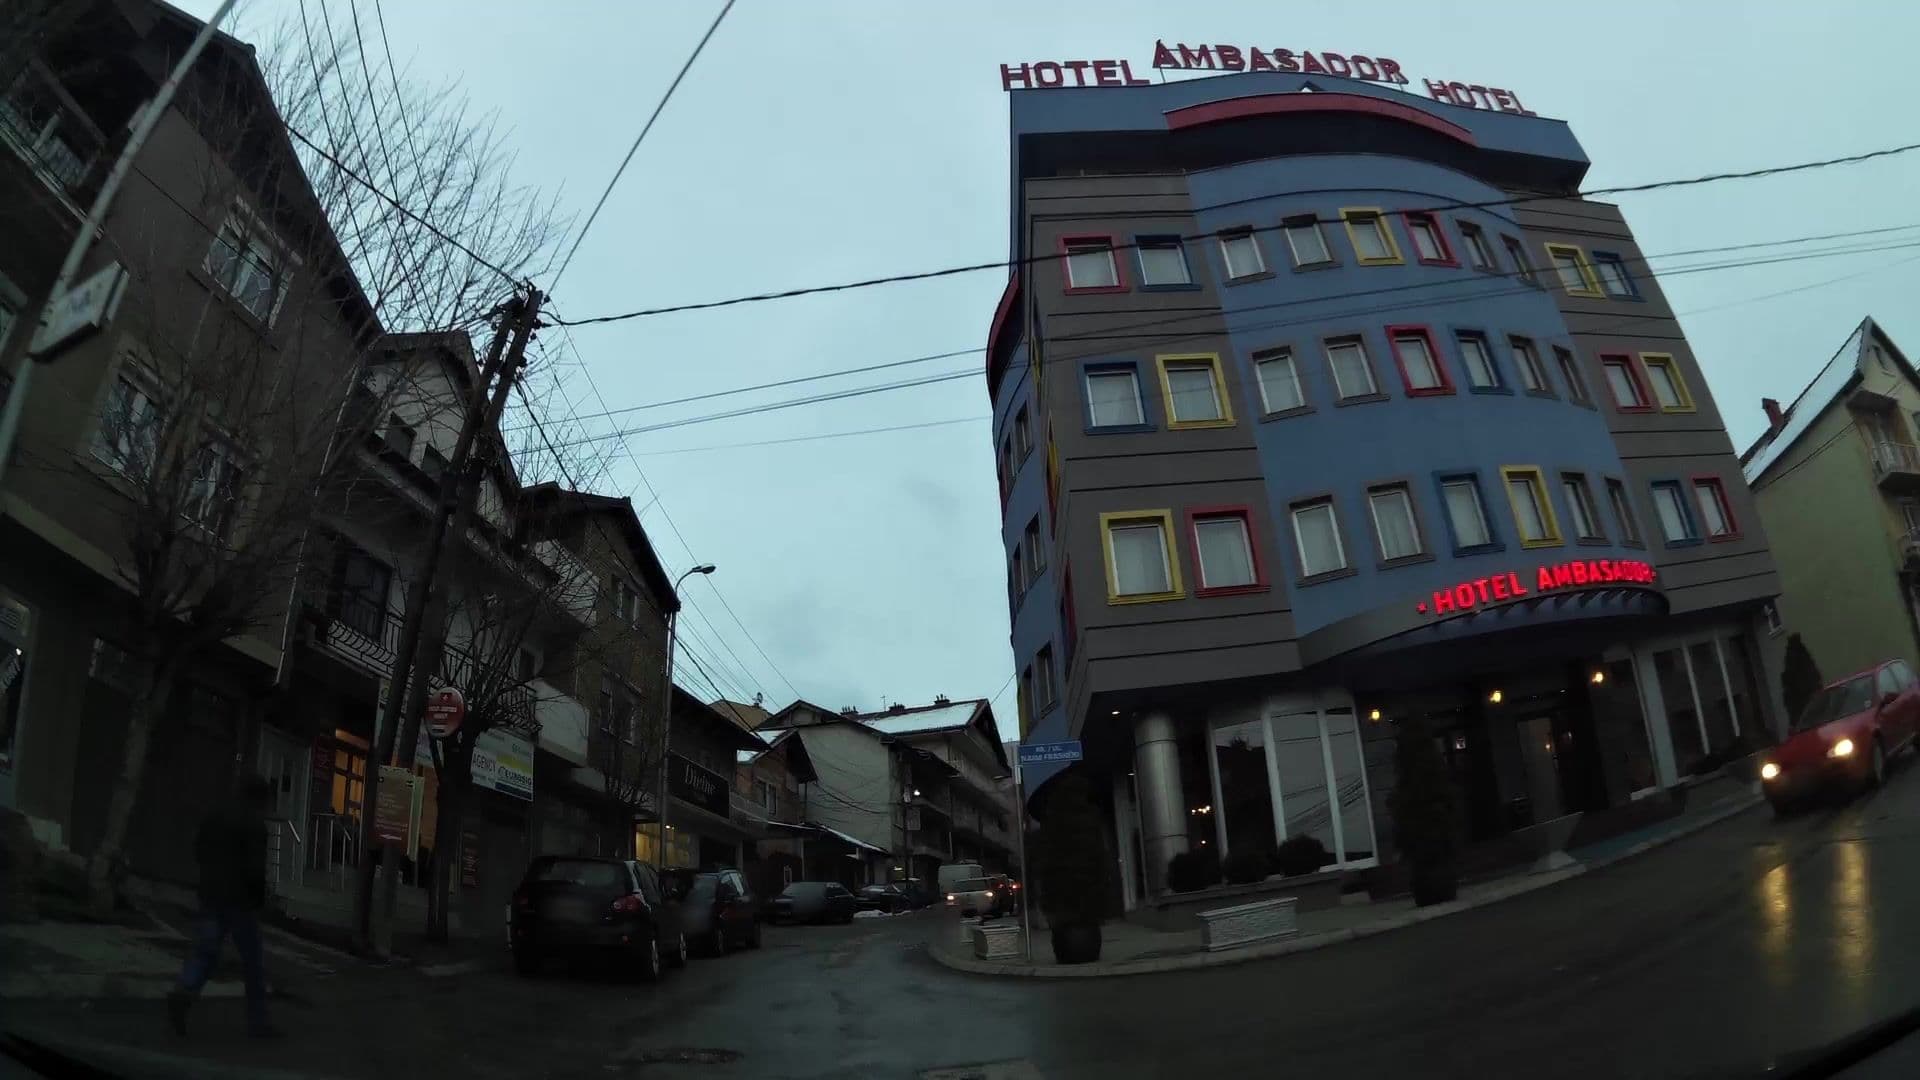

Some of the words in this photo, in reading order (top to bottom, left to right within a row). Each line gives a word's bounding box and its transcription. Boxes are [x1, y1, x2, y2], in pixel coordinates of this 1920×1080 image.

[1001, 59, 1149, 91] HOTEL
[1153, 40, 1409, 84] AMBASADOR
[1422, 78, 1537, 117] HOTEL
[1432, 571, 1528, 615] HOTEL
[1537, 559, 1654, 591] AMBASADOR
[472, 752, 496, 774] AGENCY
